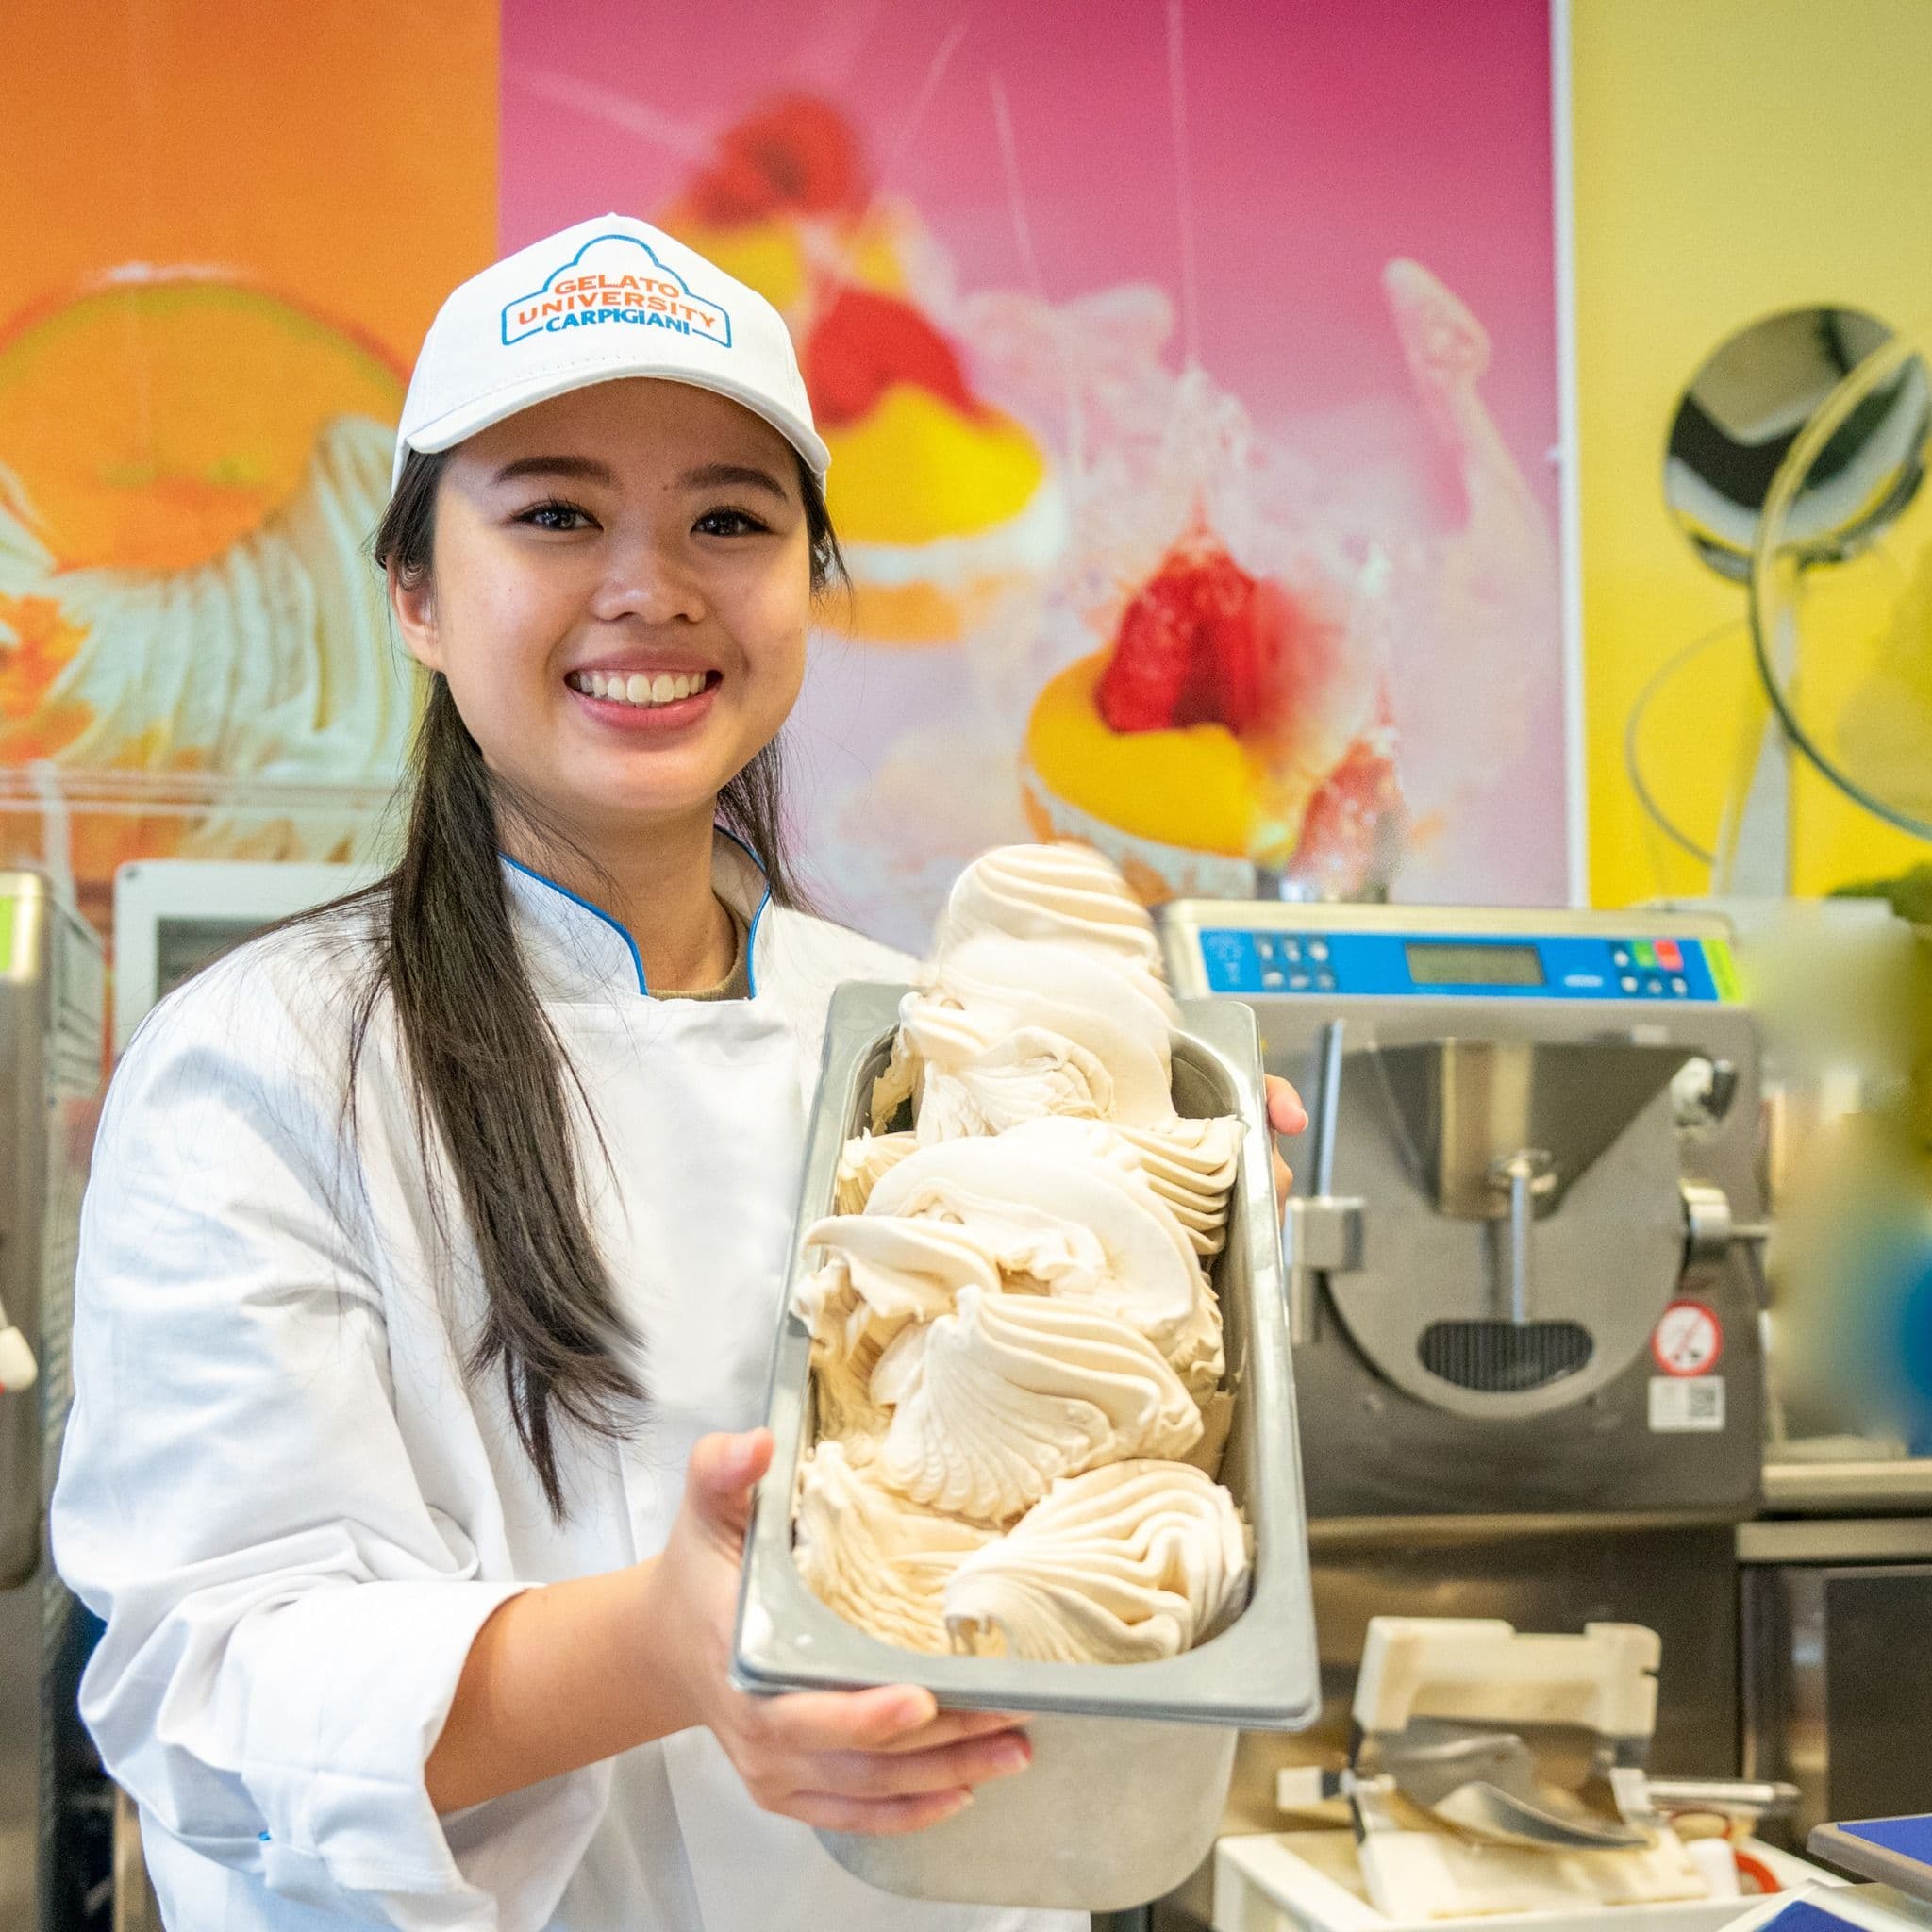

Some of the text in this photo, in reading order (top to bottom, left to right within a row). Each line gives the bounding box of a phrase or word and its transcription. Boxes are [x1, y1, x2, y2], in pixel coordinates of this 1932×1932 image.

[555, 274, 679, 298] GELATO
[519, 291, 715, 328] UNIVERSITY
[546, 308, 690, 335] CARPIGIANI
